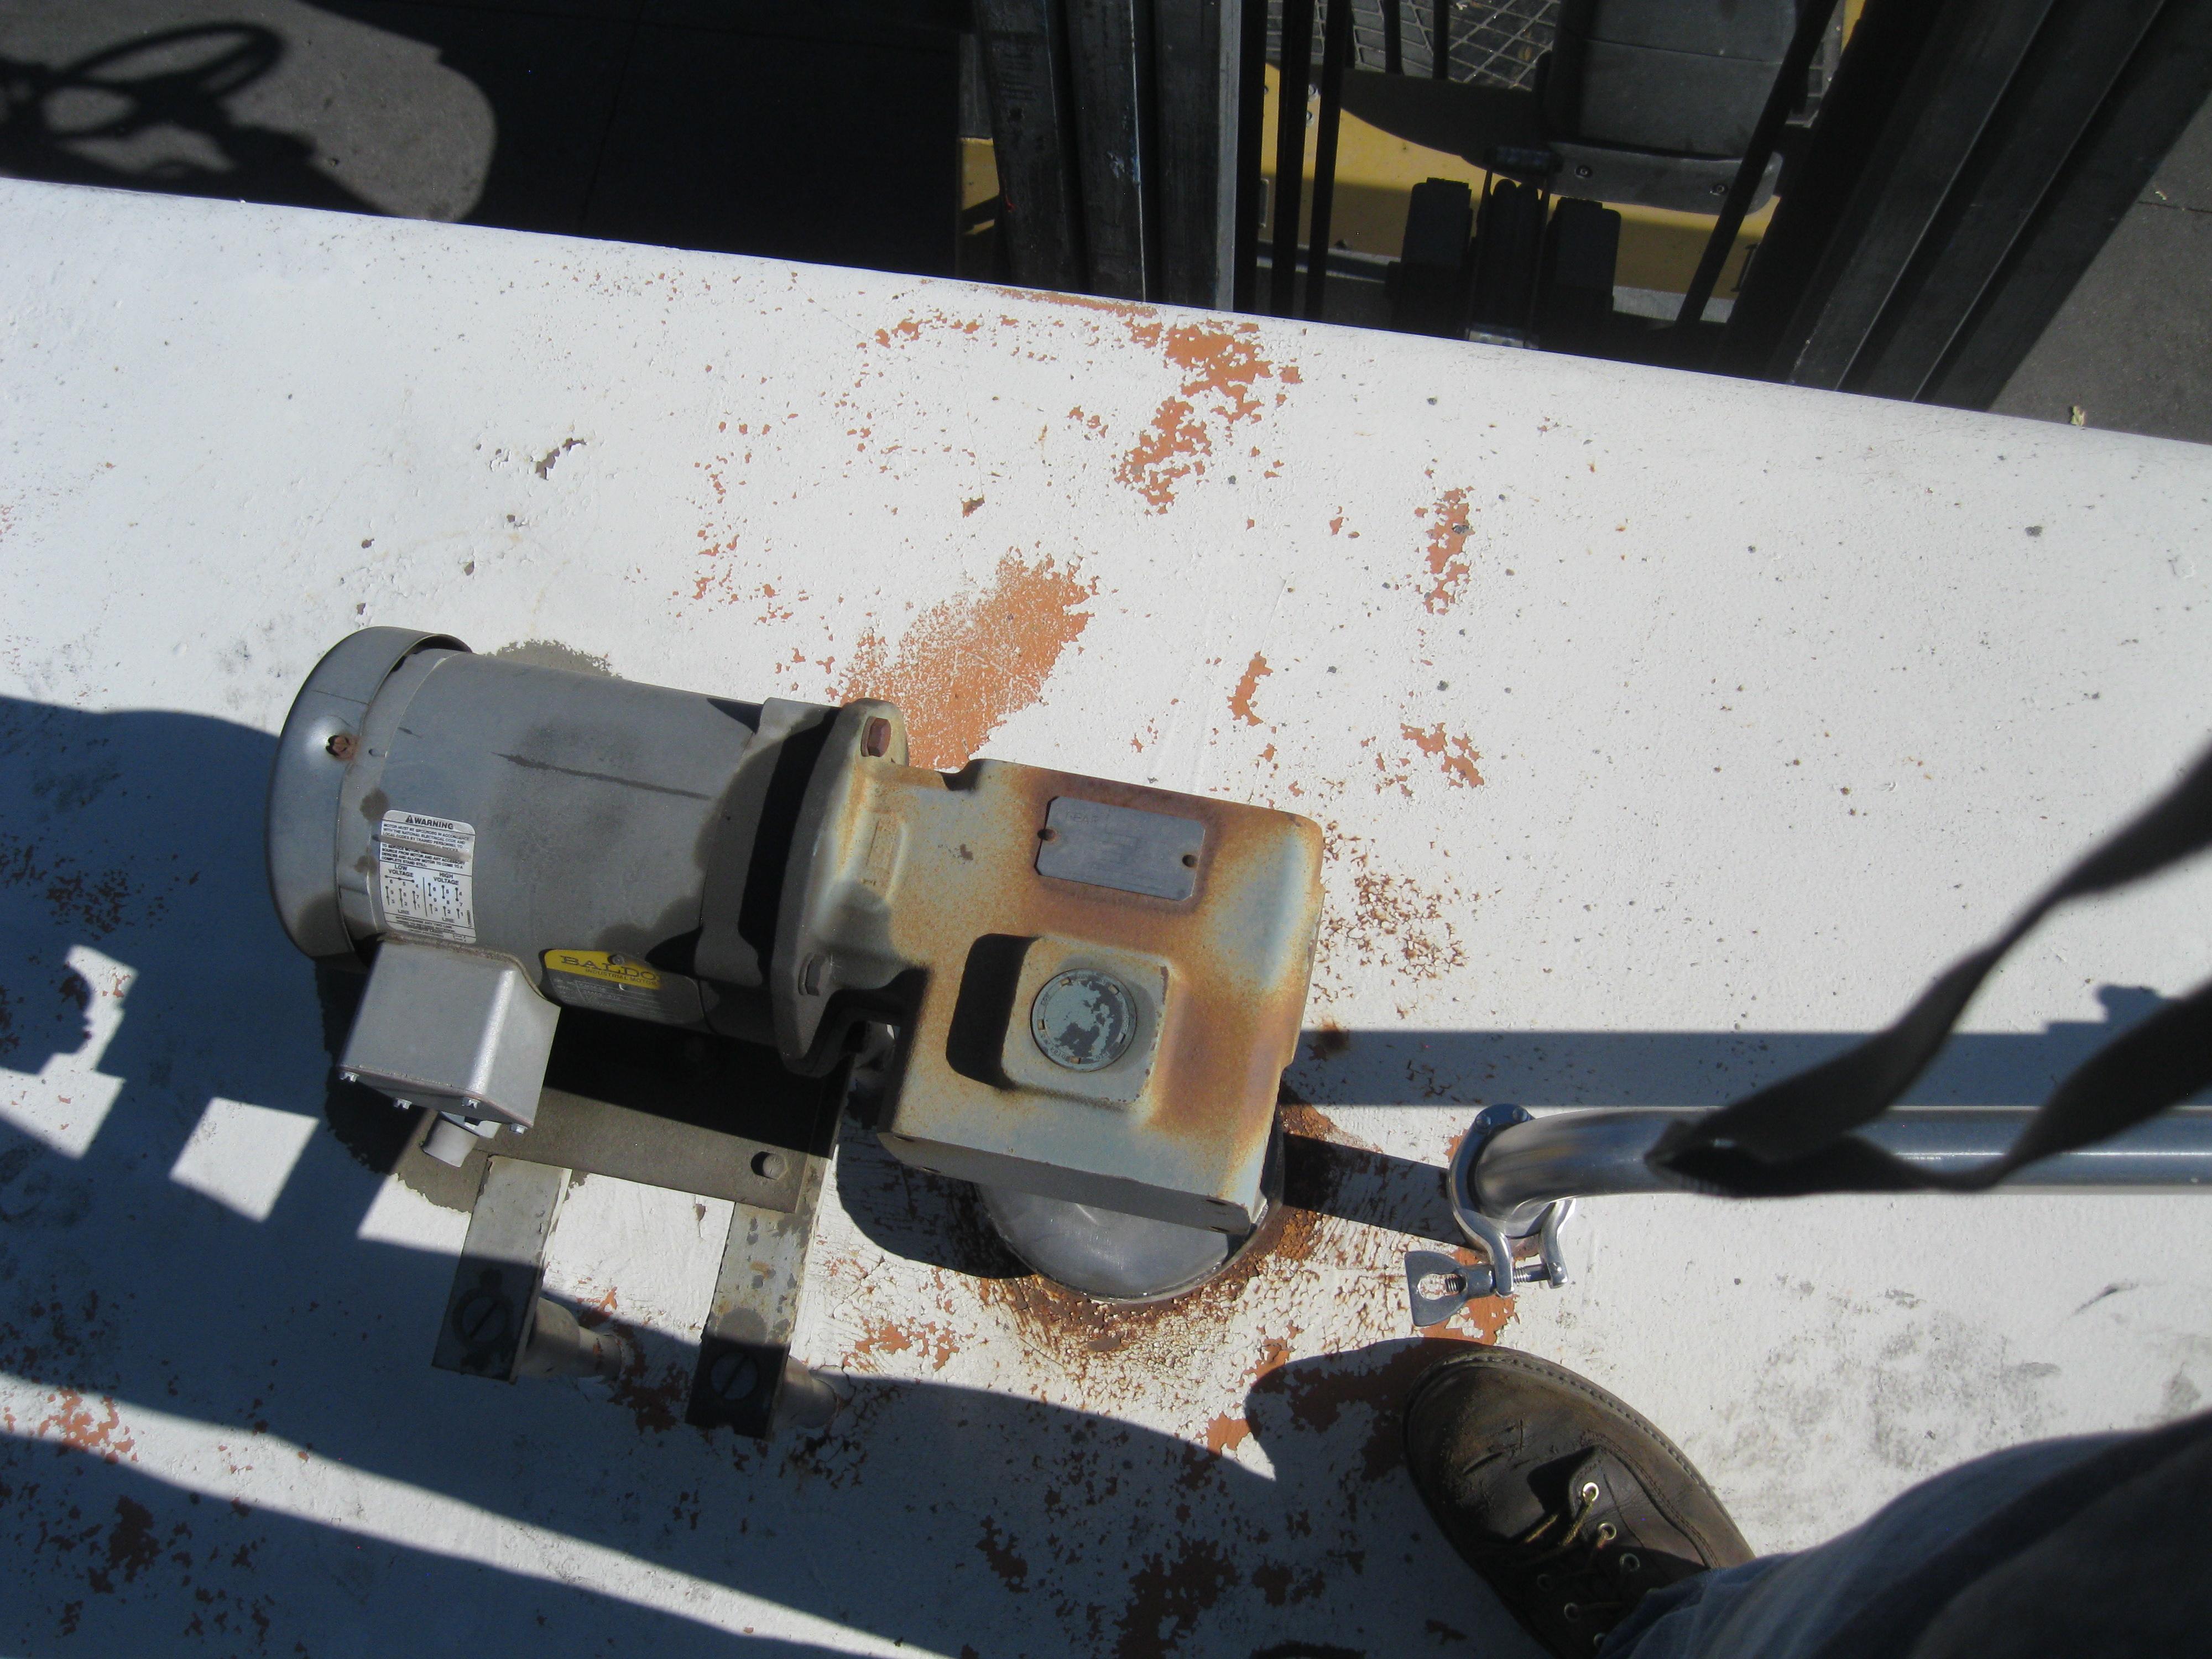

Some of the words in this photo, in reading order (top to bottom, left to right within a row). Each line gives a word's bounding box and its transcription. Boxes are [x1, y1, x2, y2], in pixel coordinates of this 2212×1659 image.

[414, 817, 454, 830] WARNING
[388, 868, 414, 877] VOLTAGE
[434, 877, 460, 885] VOLTAGE
[560, 955, 661, 981] BALDO
[585, 968, 628, 980] INDUSTRIAL
